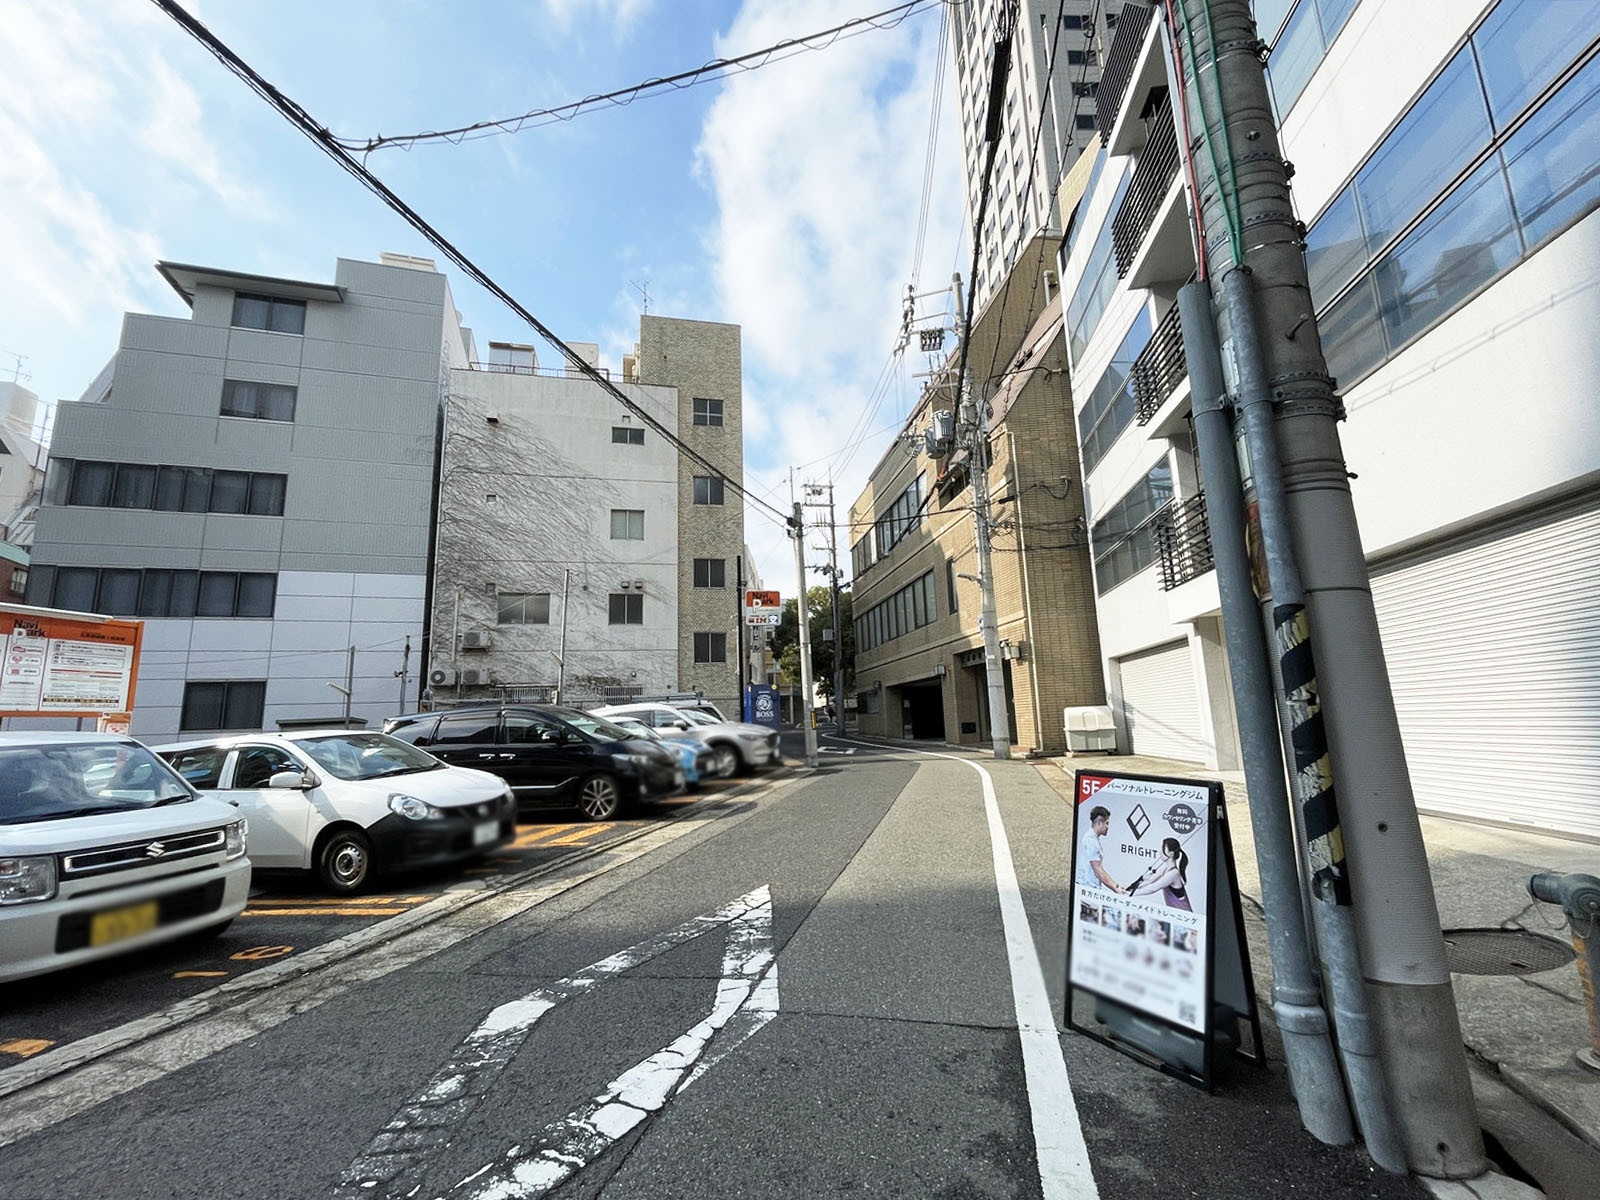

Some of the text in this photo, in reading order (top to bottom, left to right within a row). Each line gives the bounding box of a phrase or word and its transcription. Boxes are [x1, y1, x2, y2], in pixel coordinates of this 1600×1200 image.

[14, 619, 39, 629] Navi
[11, 627, 45, 644] Park
[756, 710, 775, 718] BOSS
[1107, 783, 1203, 800] パーソナルトレーニングジム
[1121, 844, 1158, 859] BRIGHT
